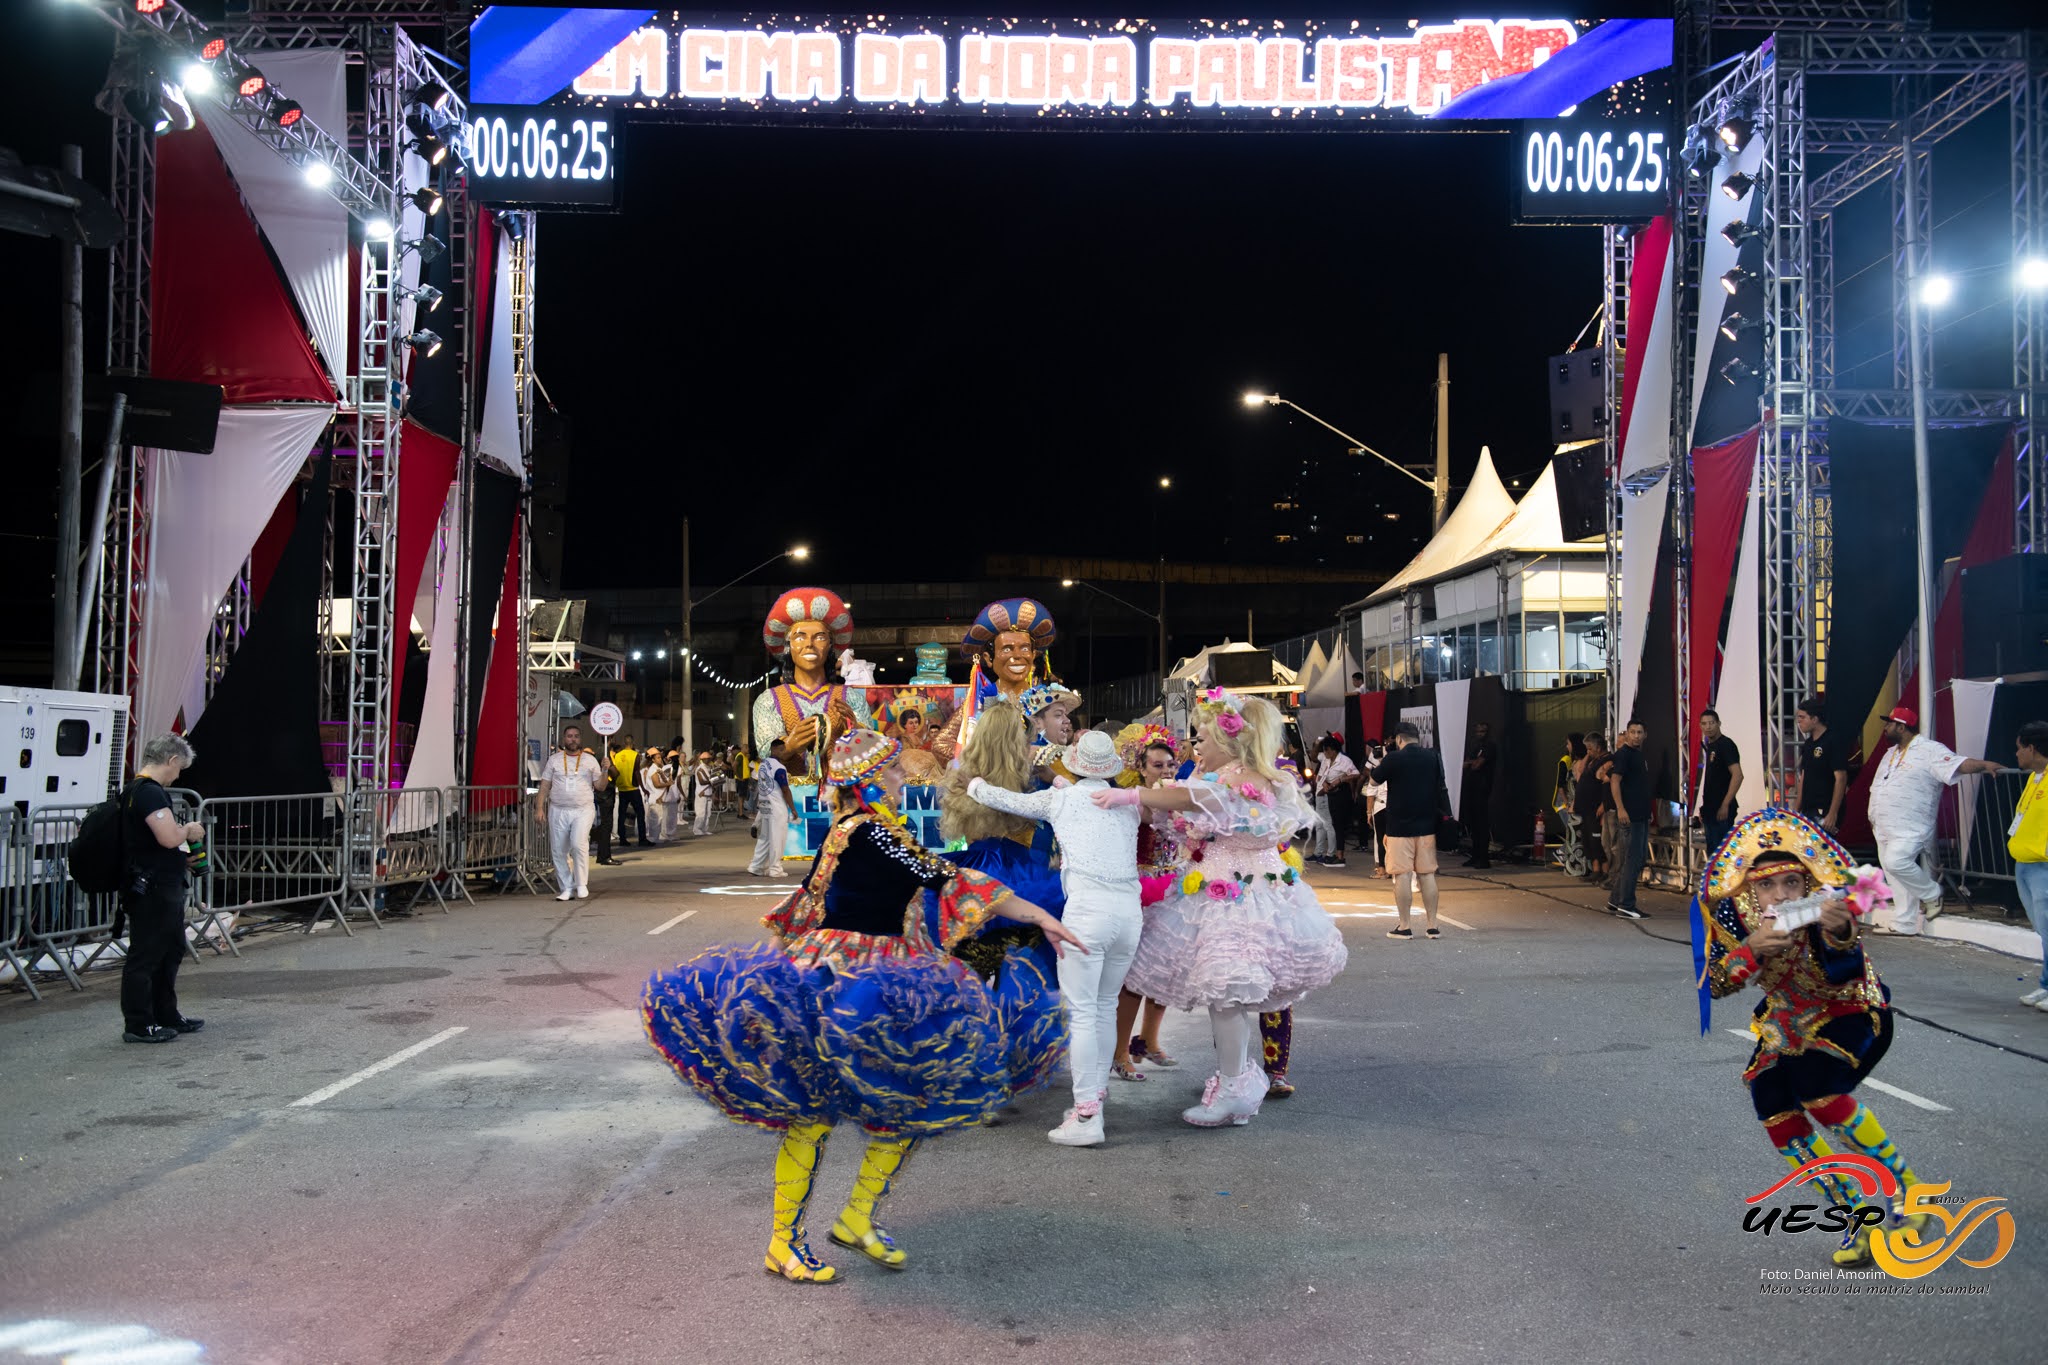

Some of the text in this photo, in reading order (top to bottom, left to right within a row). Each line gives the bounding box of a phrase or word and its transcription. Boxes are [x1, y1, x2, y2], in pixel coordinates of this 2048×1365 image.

[679, 28, 843, 100] CIMA
[854, 33, 947, 103] DA
[959, 34, 1137, 108] HORA
[472, 116, 609, 181] 00:06:25
[1526, 131, 1664, 193] 00:06:25
[20, 726, 35, 740] 139
